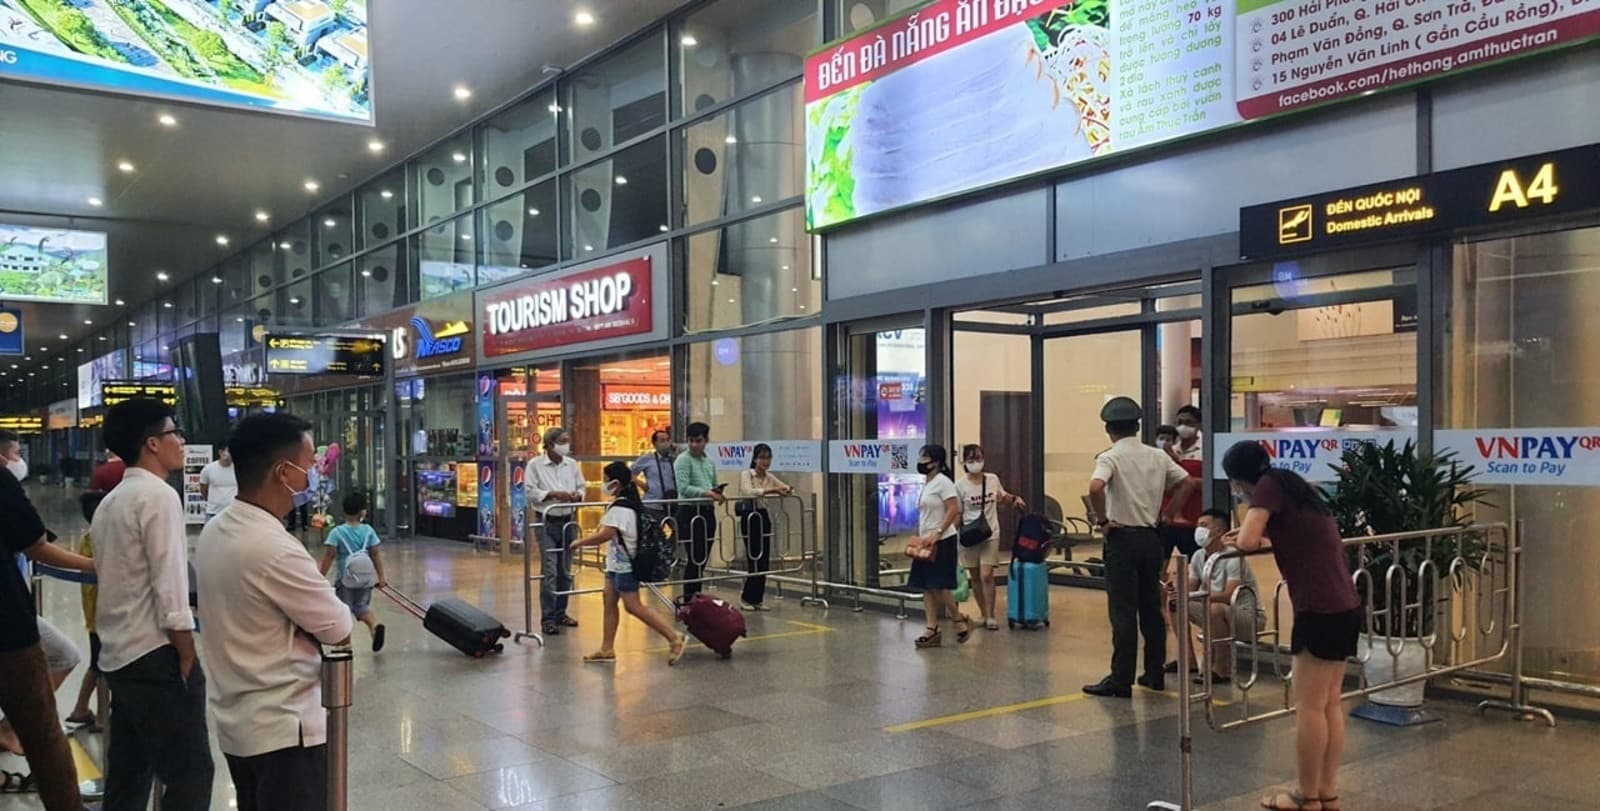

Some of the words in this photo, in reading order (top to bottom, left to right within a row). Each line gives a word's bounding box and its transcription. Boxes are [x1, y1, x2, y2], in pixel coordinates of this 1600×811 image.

[1188, 11, 1201, 24] 70
[1207, 6, 1221, 18] kg
[1271, 32, 1287, 45] 04
[1291, 25, 1305, 40] Lê
[1354, 8, 1370, 21] Q.
[1272, 9, 1295, 26] 300
[1300, 0, 1321, 18] Hải
[818, 46, 855, 90] ĐẾN
[859, 34, 886, 74] ĐÀ
[891, 13, 950, 61] NẴNG
[1271, 48, 1309, 66] Phạm
[1313, 37, 1340, 54] Văn
[1392, 18, 1409, 31] Q.
[1414, 11, 1442, 26] Sơn
[1272, 71, 1287, 85] 15
[1291, 55, 1343, 80] Nguyễn
[1347, 49, 1375, 65] Văn
[1381, 39, 1409, 56] Linh
[1426, 24, 1459, 44] Gần
[1465, 13, 1500, 34] Cầu
[1193, 63, 1222, 78] canh
[1279, 29, 1557, 107] facebook.com/hethong.amthuctran
[1489, 163, 1559, 212] A4
[1326, 214, 1383, 234] Domestic
[1384, 206, 1434, 225] Arrivals
[486, 287, 567, 336] TOURISM
[570, 272, 632, 320] SHOP
[844, 444, 881, 458] VNPAY
[1260, 439, 1321, 458] NPAY
[1321, 439, 1338, 451] QR
[1475, 436, 1579, 459] VNPAY
[1293, 460, 1312, 474] Pay
[1487, 461, 1518, 474] Scan
[1522, 462, 1536, 474] to
[1540, 461, 1566, 476] Pay
